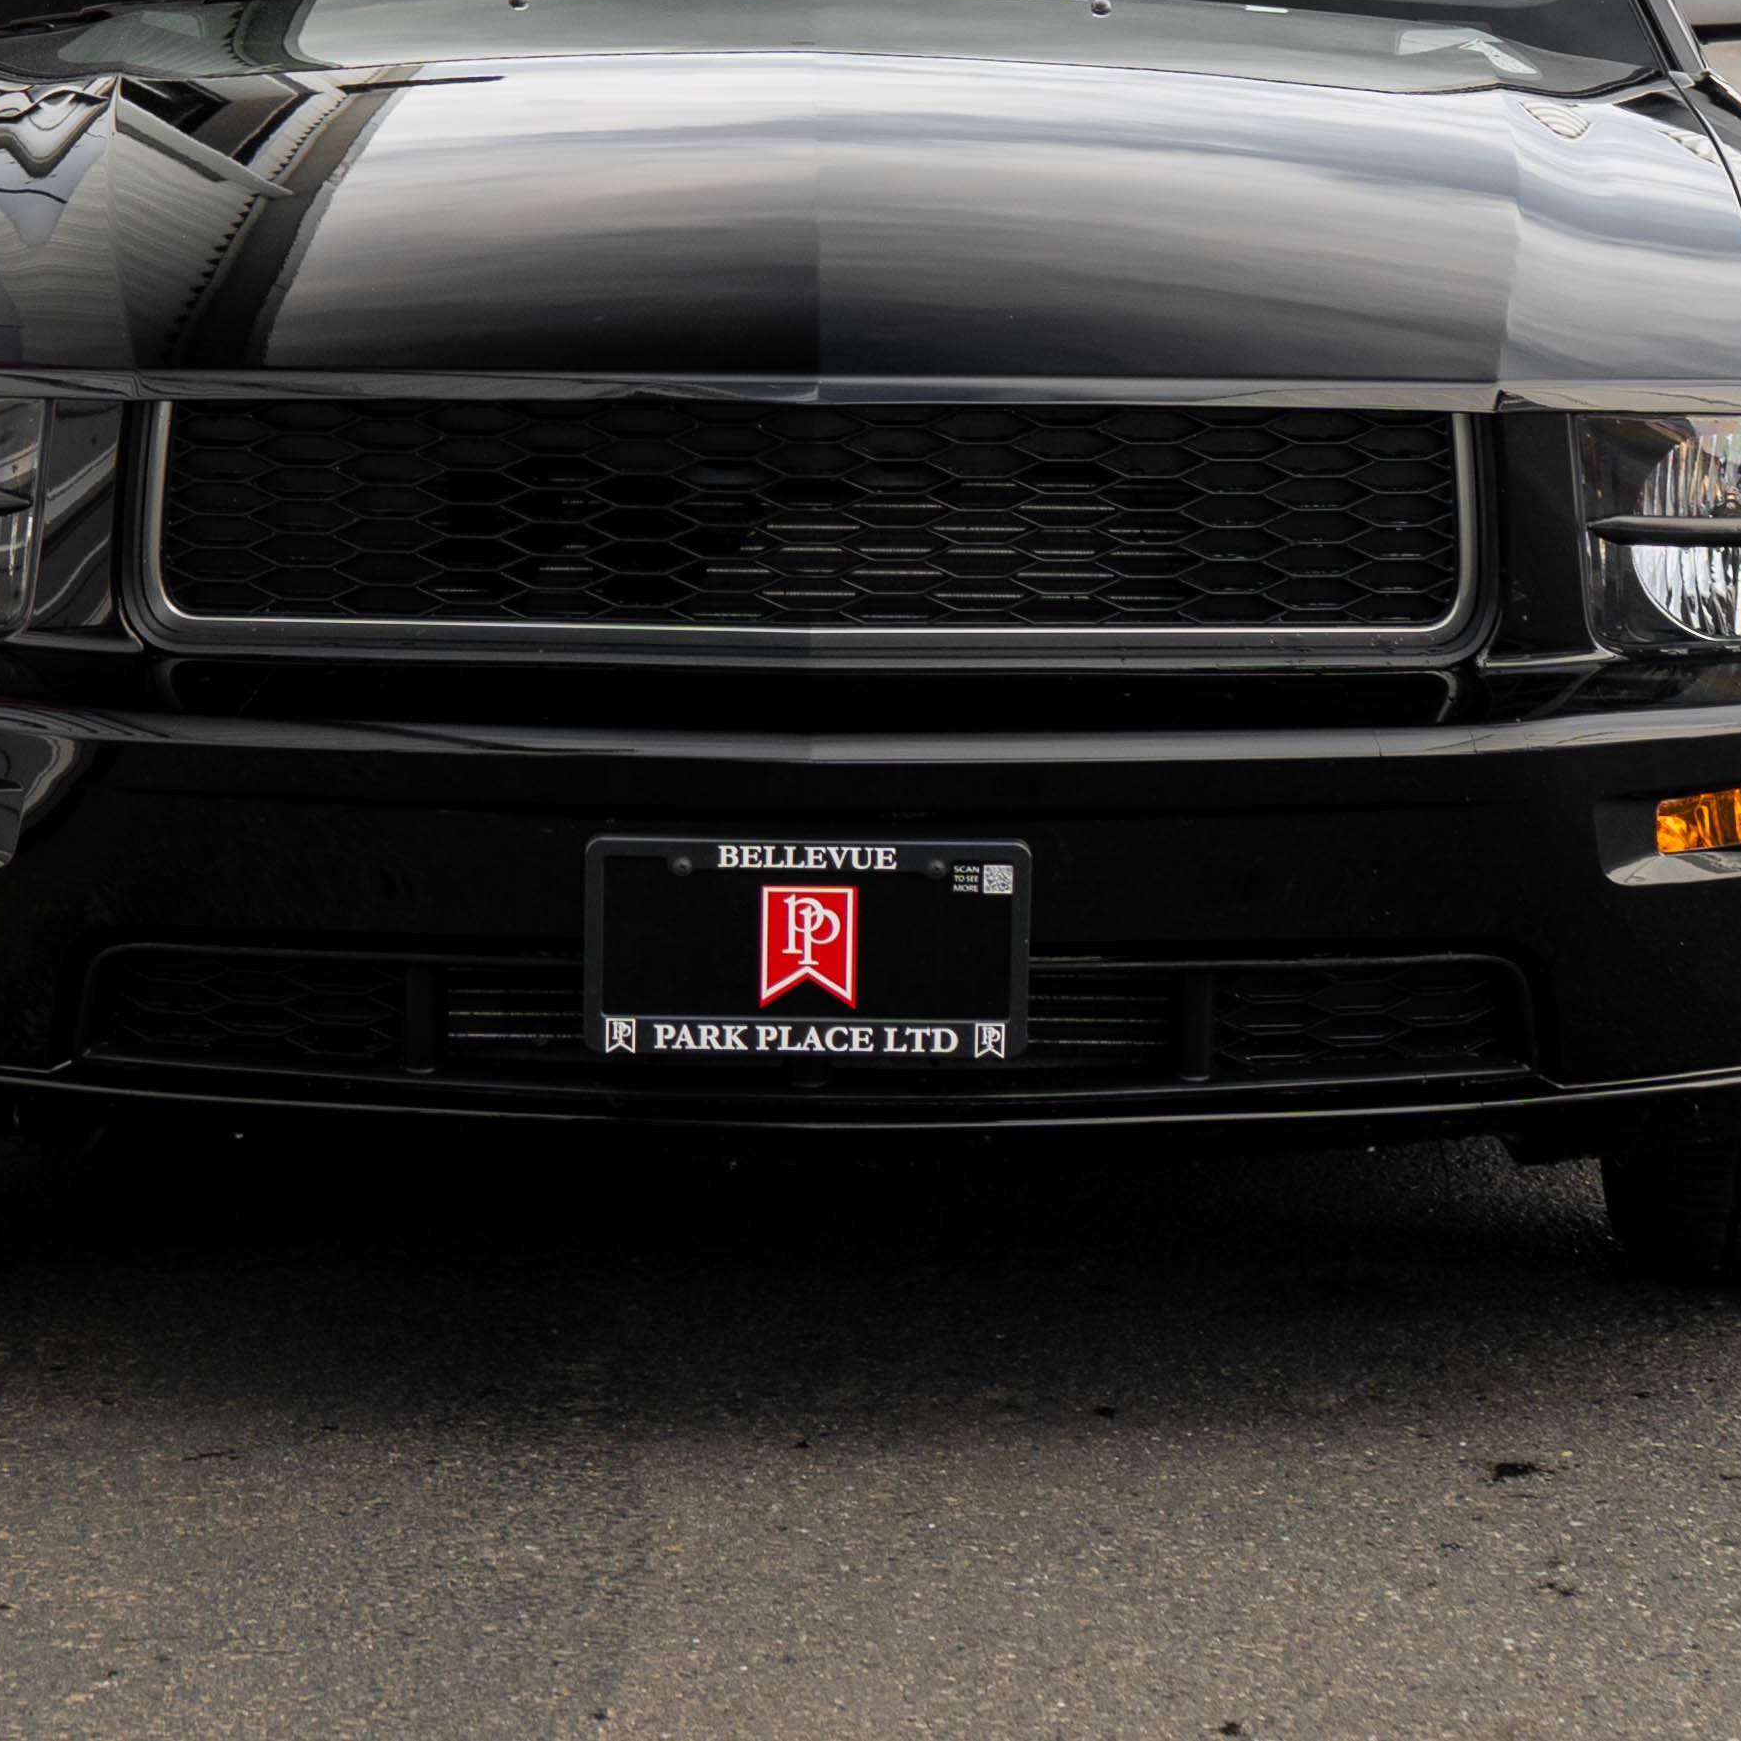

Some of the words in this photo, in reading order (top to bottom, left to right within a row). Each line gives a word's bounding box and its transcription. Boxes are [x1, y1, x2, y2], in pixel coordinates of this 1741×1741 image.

[717, 844, 898, 871] BELLEVUE
[953, 865, 980, 874] SCAN
[953, 874, 965, 882] TO
[966, 875, 979, 883] SEE
[952, 884, 979, 893] MORE
[653, 1023, 749, 1050] PARK
[755, 1025, 874, 1052] PLACE
[883, 1027, 959, 1053] LTD
